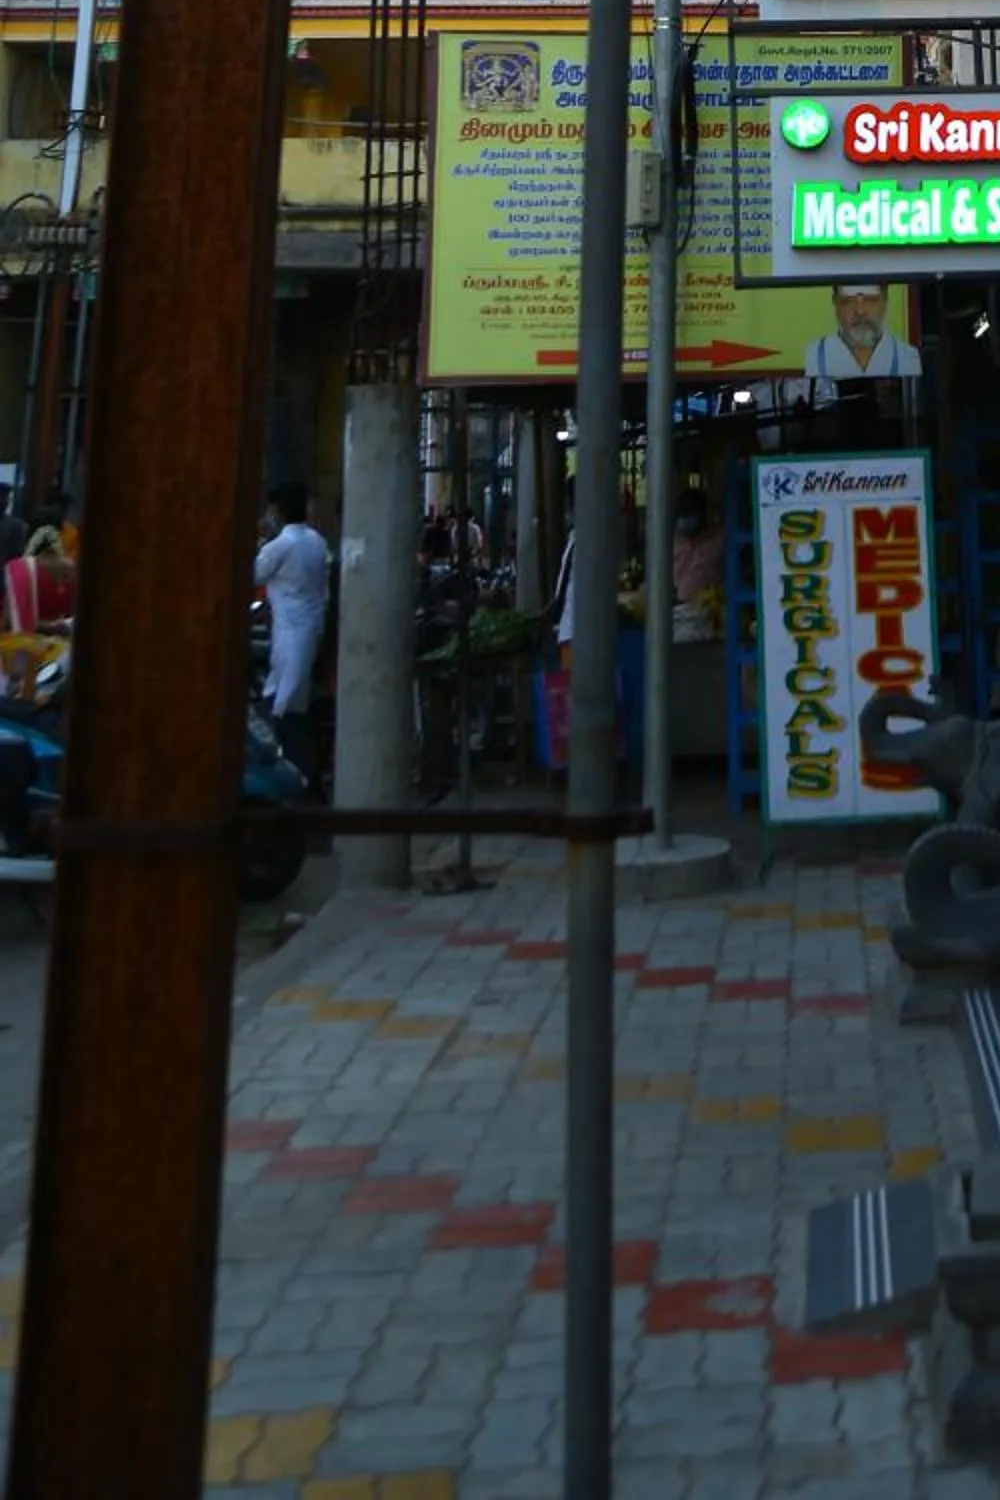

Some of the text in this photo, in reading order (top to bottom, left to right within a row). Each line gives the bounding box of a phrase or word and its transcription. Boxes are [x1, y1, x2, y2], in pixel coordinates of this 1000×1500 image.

[803, 188, 942, 238] Medical
[952, 187, 978, 235] &
[855, 111, 909, 153] Sri
[777, 508, 845, 799] SURGICALS
[853, 505, 927, 792] MEDIC
